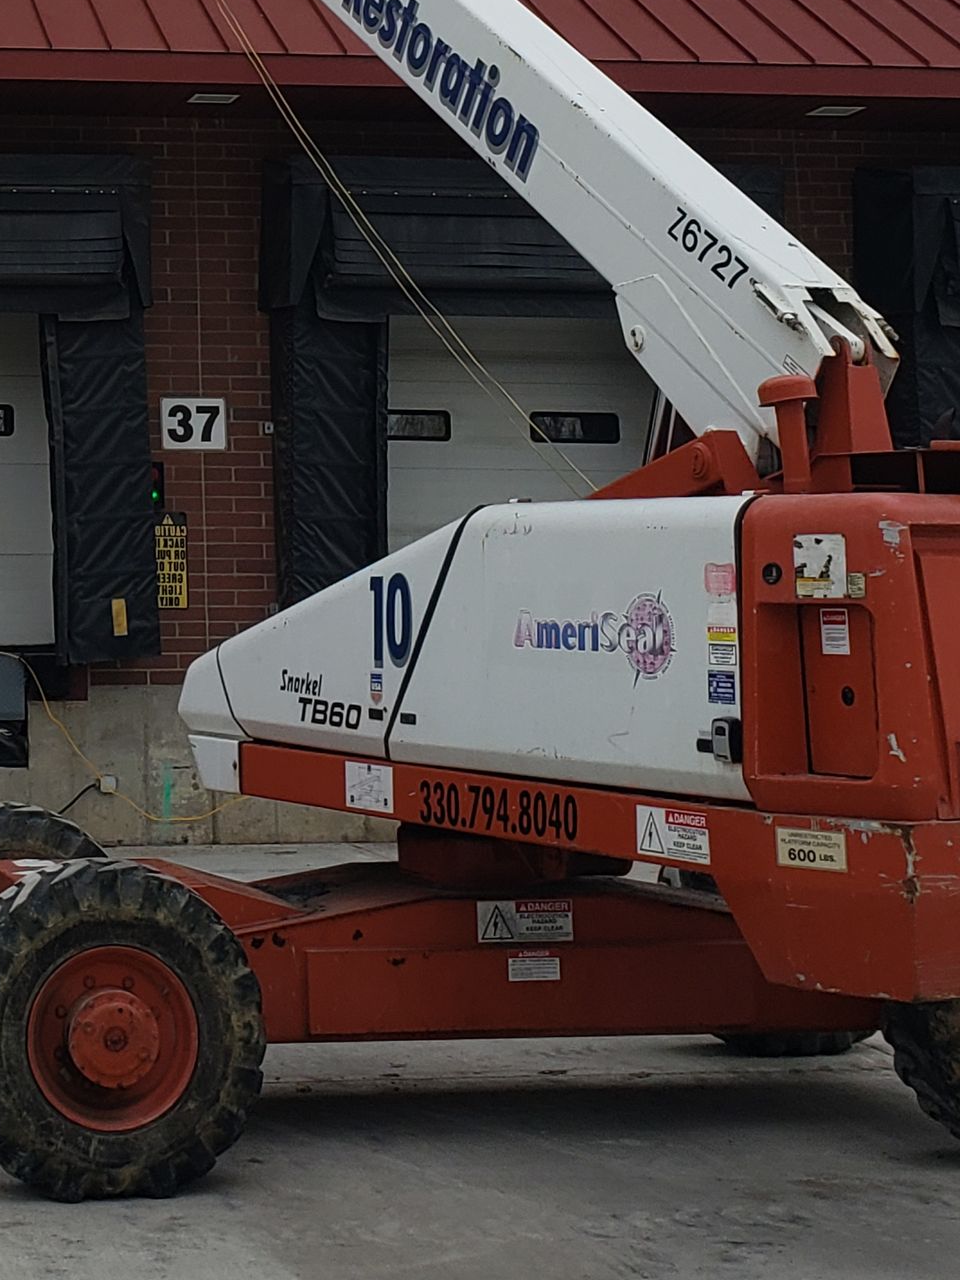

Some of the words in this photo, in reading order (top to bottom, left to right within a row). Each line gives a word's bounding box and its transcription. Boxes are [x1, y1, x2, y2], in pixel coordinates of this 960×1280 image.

[667, 206, 750, 289] Z6727
[167, 404, 220, 443] 37
[370, 572, 413, 669] 10
[514, 609, 665, 656] AmeriSeal
[280, 669, 323, 697] Snorkel
[371, 682, 383, 691] USA
[298, 696, 362, 730] TB60
[420, 780, 578, 841] 330.794.8040
[674, 813, 707, 827] DANGER
[788, 847, 816, 863] 600
[527, 902, 569, 911] DANGER
